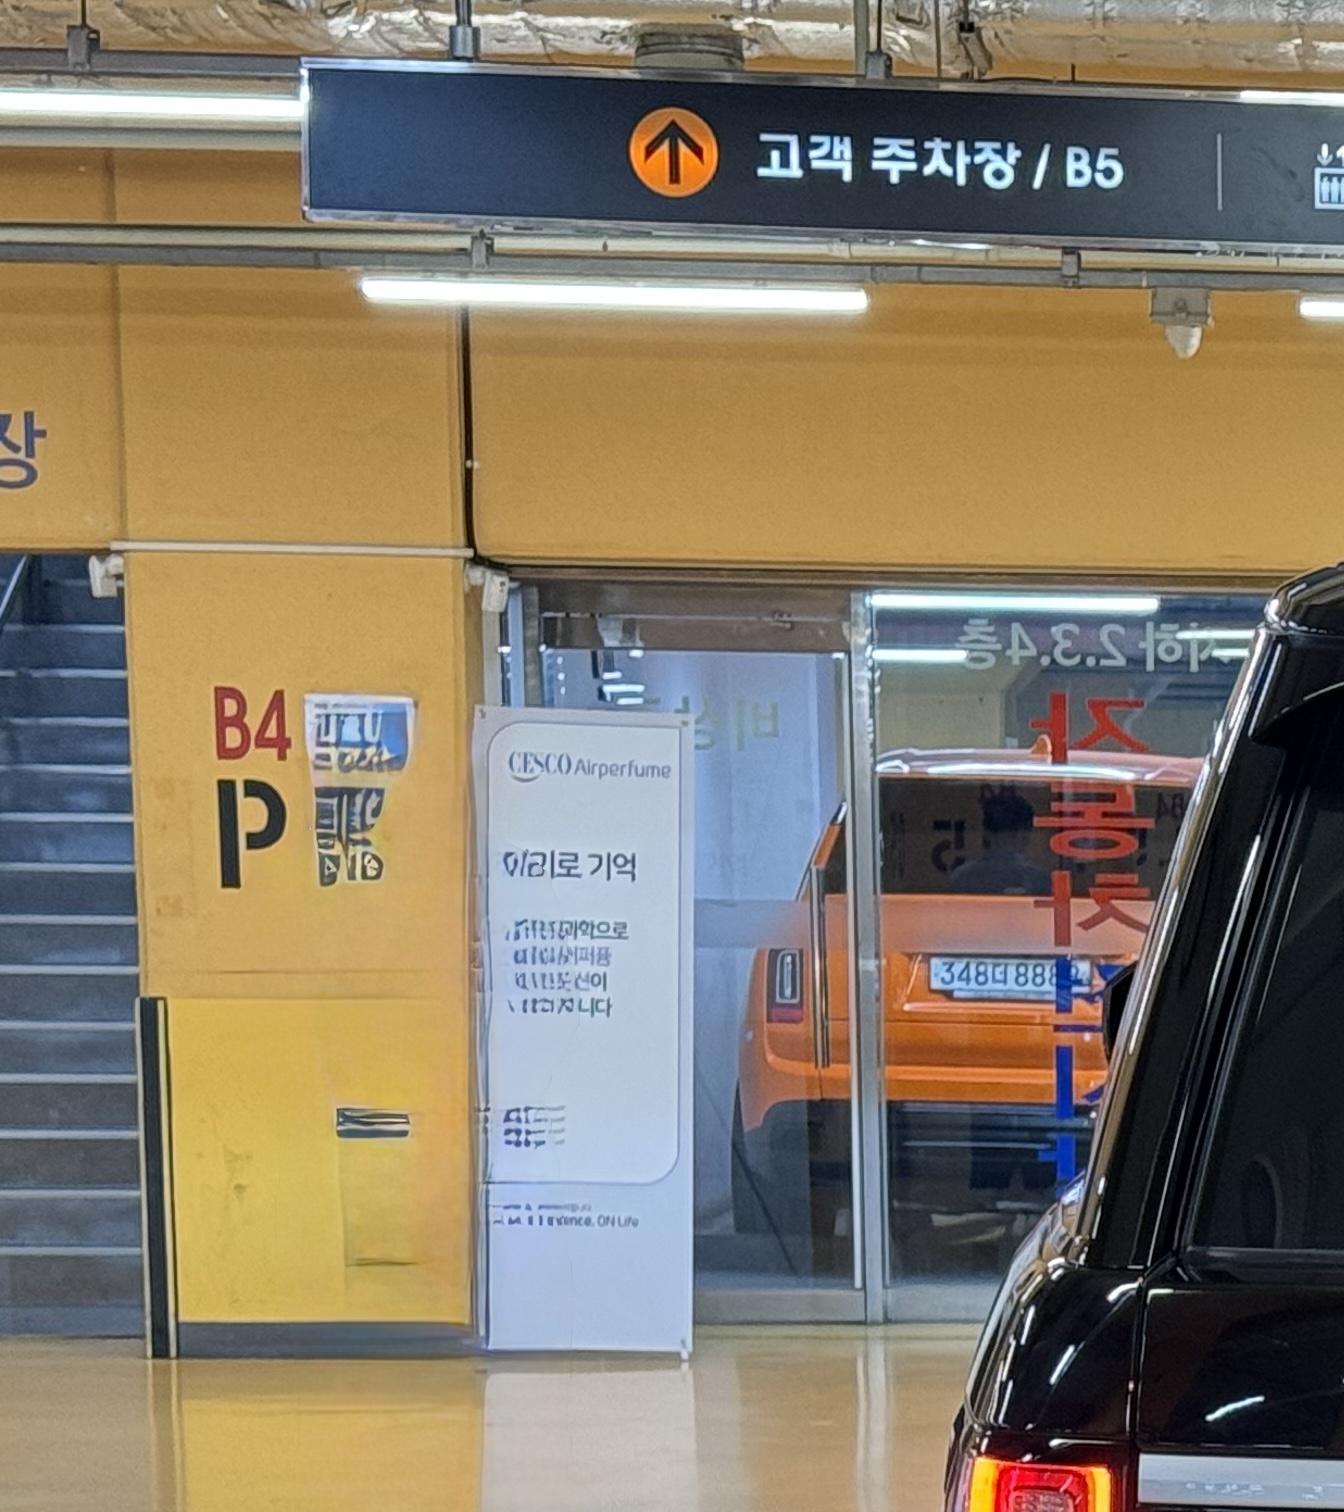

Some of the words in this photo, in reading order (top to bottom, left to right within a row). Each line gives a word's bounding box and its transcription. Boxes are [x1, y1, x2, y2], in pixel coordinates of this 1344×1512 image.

[756, 133, 852, 183] 고객
[871, 137, 1022, 190] 주차장
[1065, 146, 1124, 189] B5
[214, 686, 292, 761] B4
[508, 751, 572, 782] CESCO
[574, 758, 672, 780] Airperfume
[217, 779, 287, 888] P
[587, 851, 637, 882] 기억
